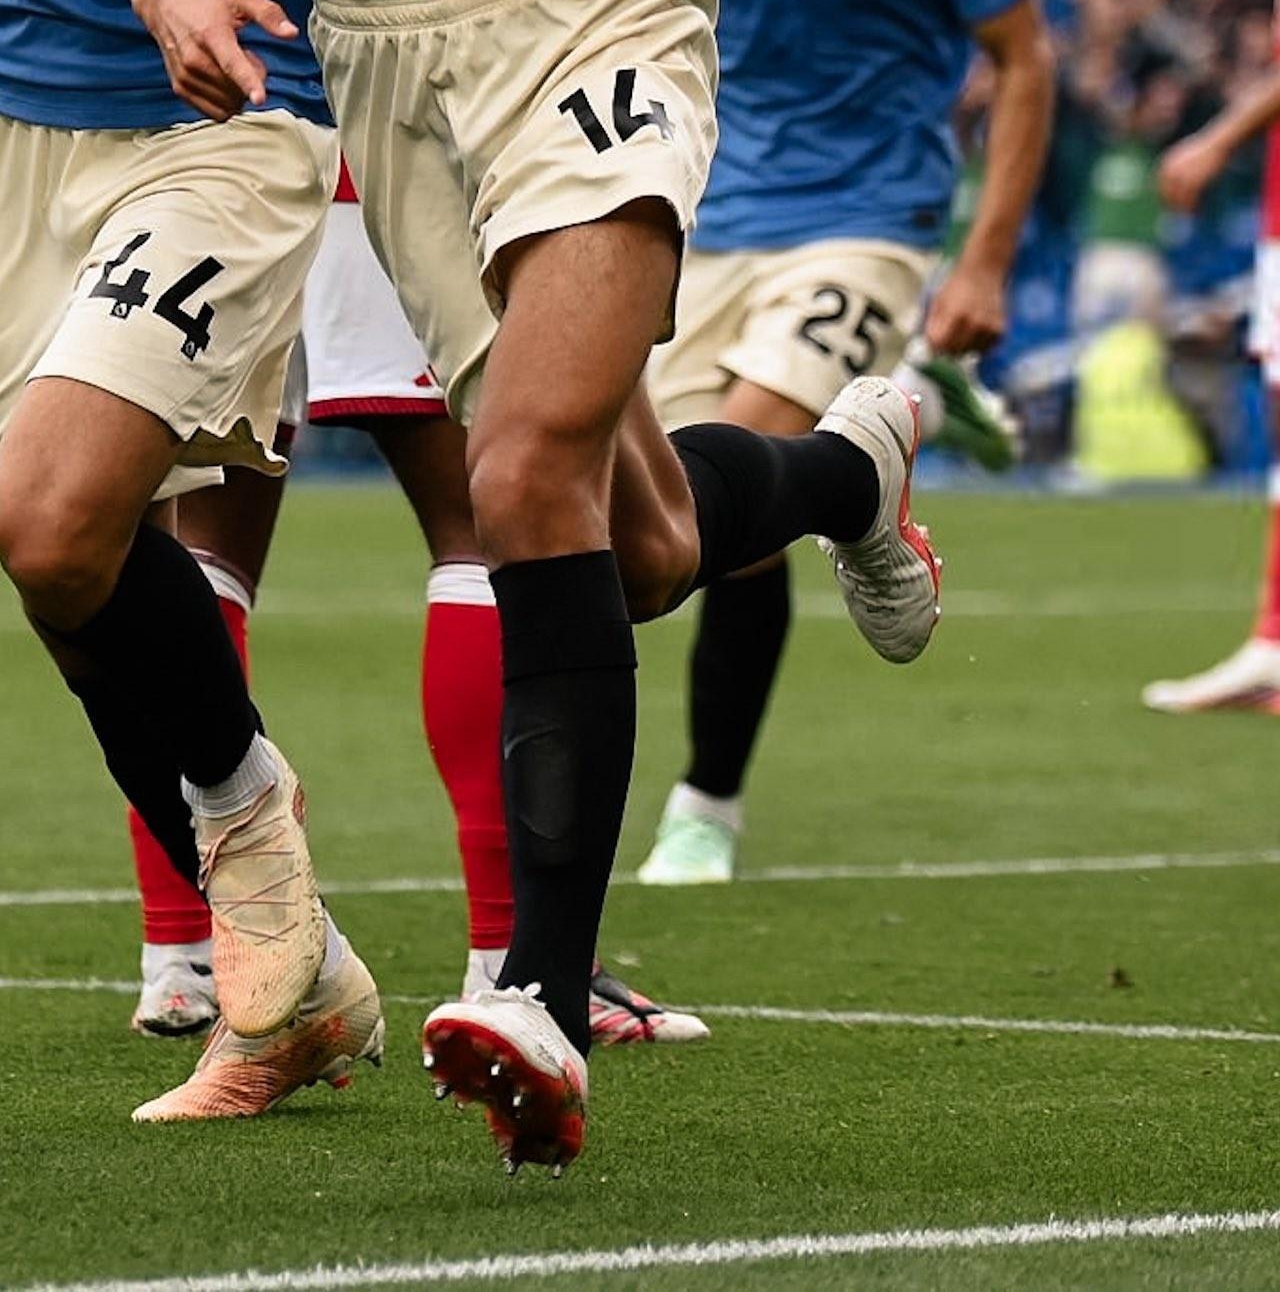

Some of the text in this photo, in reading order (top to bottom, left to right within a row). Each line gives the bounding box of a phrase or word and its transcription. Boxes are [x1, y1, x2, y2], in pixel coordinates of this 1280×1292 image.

[557, 67, 675, 154] 14
[88, 232, 225, 361] 44
[797, 284, 892, 376] 25
